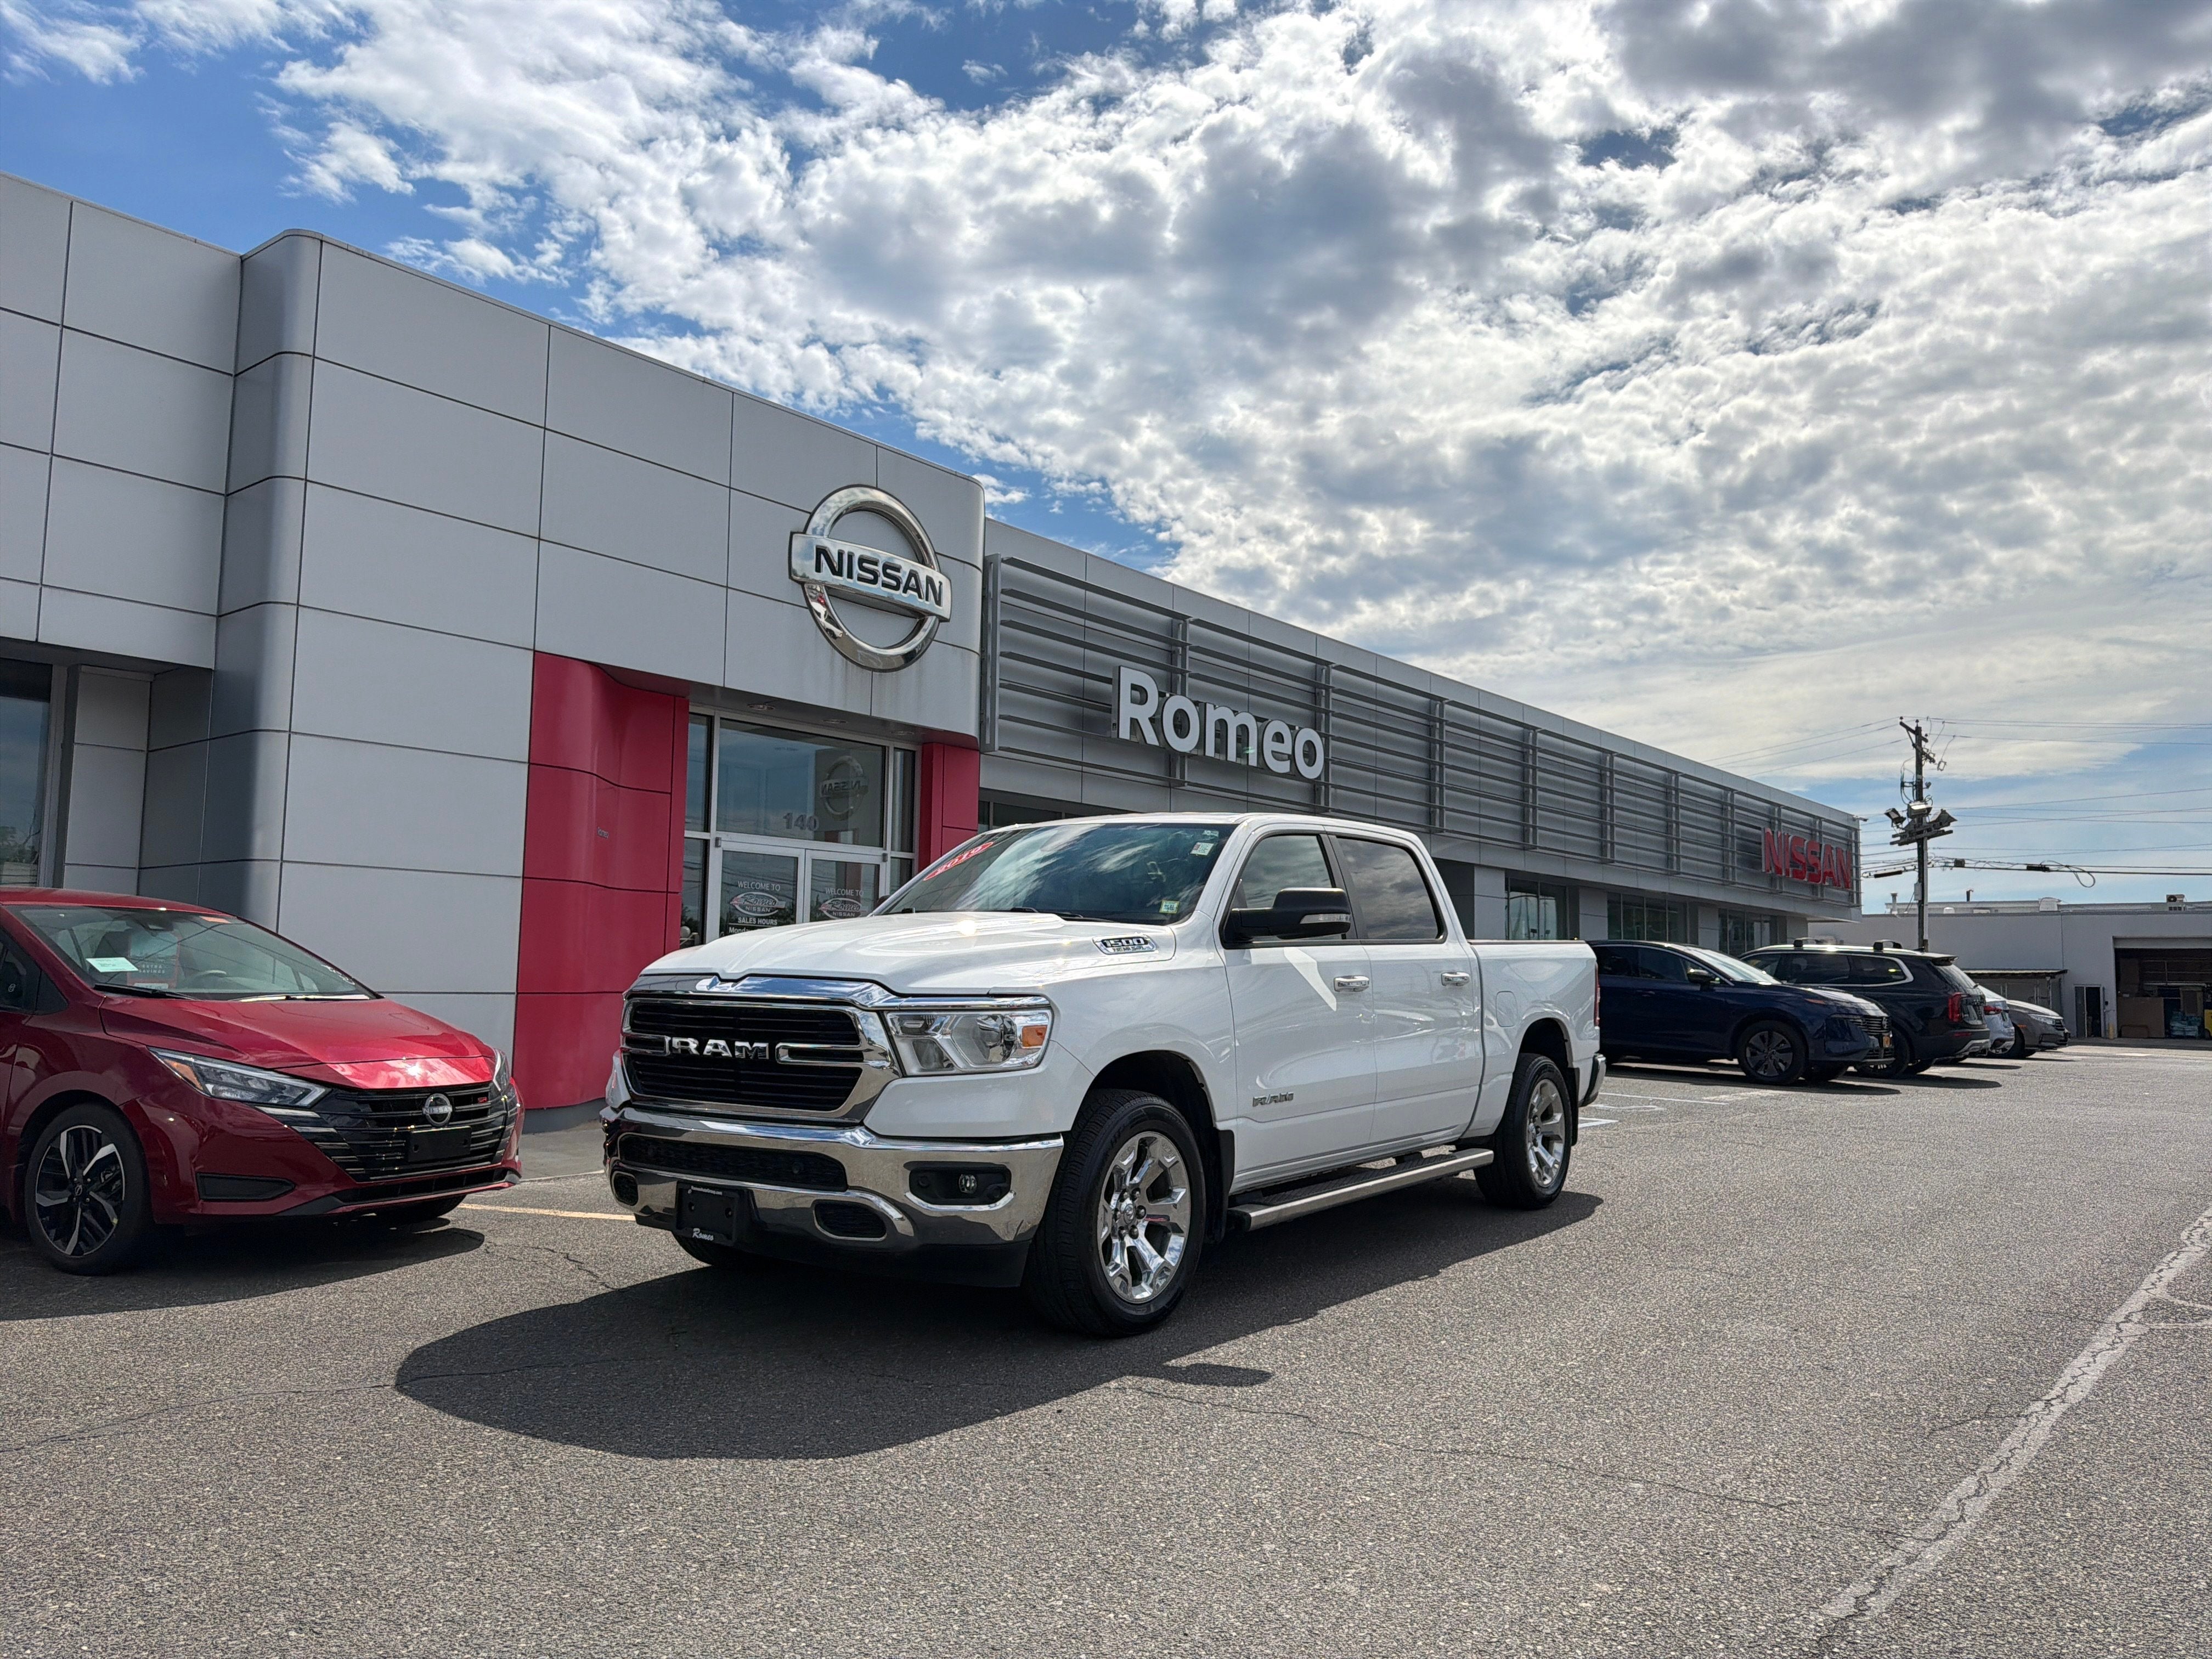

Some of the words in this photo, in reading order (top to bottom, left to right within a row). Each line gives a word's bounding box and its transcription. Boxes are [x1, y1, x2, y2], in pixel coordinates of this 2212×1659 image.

[815, 545, 943, 607] NISSAN
[1115, 665, 1324, 780] Romeo
[783, 812, 819, 831] 140
[1763, 827, 1852, 889] NISSAN
[738, 881, 770, 890] WELCOME
[825, 888, 854, 896] WELCOME
[743, 894, 776, 906] Romeo
[829, 899, 861, 911] Romeo
[1102, 938, 1145, 947] 1500
[672, 1037, 769, 1060] RAM
[1252, 1092, 1294, 1107] RAM
[424, 1105, 453, 1114] NISSAN
[692, 1228, 714, 1241] Romeo
